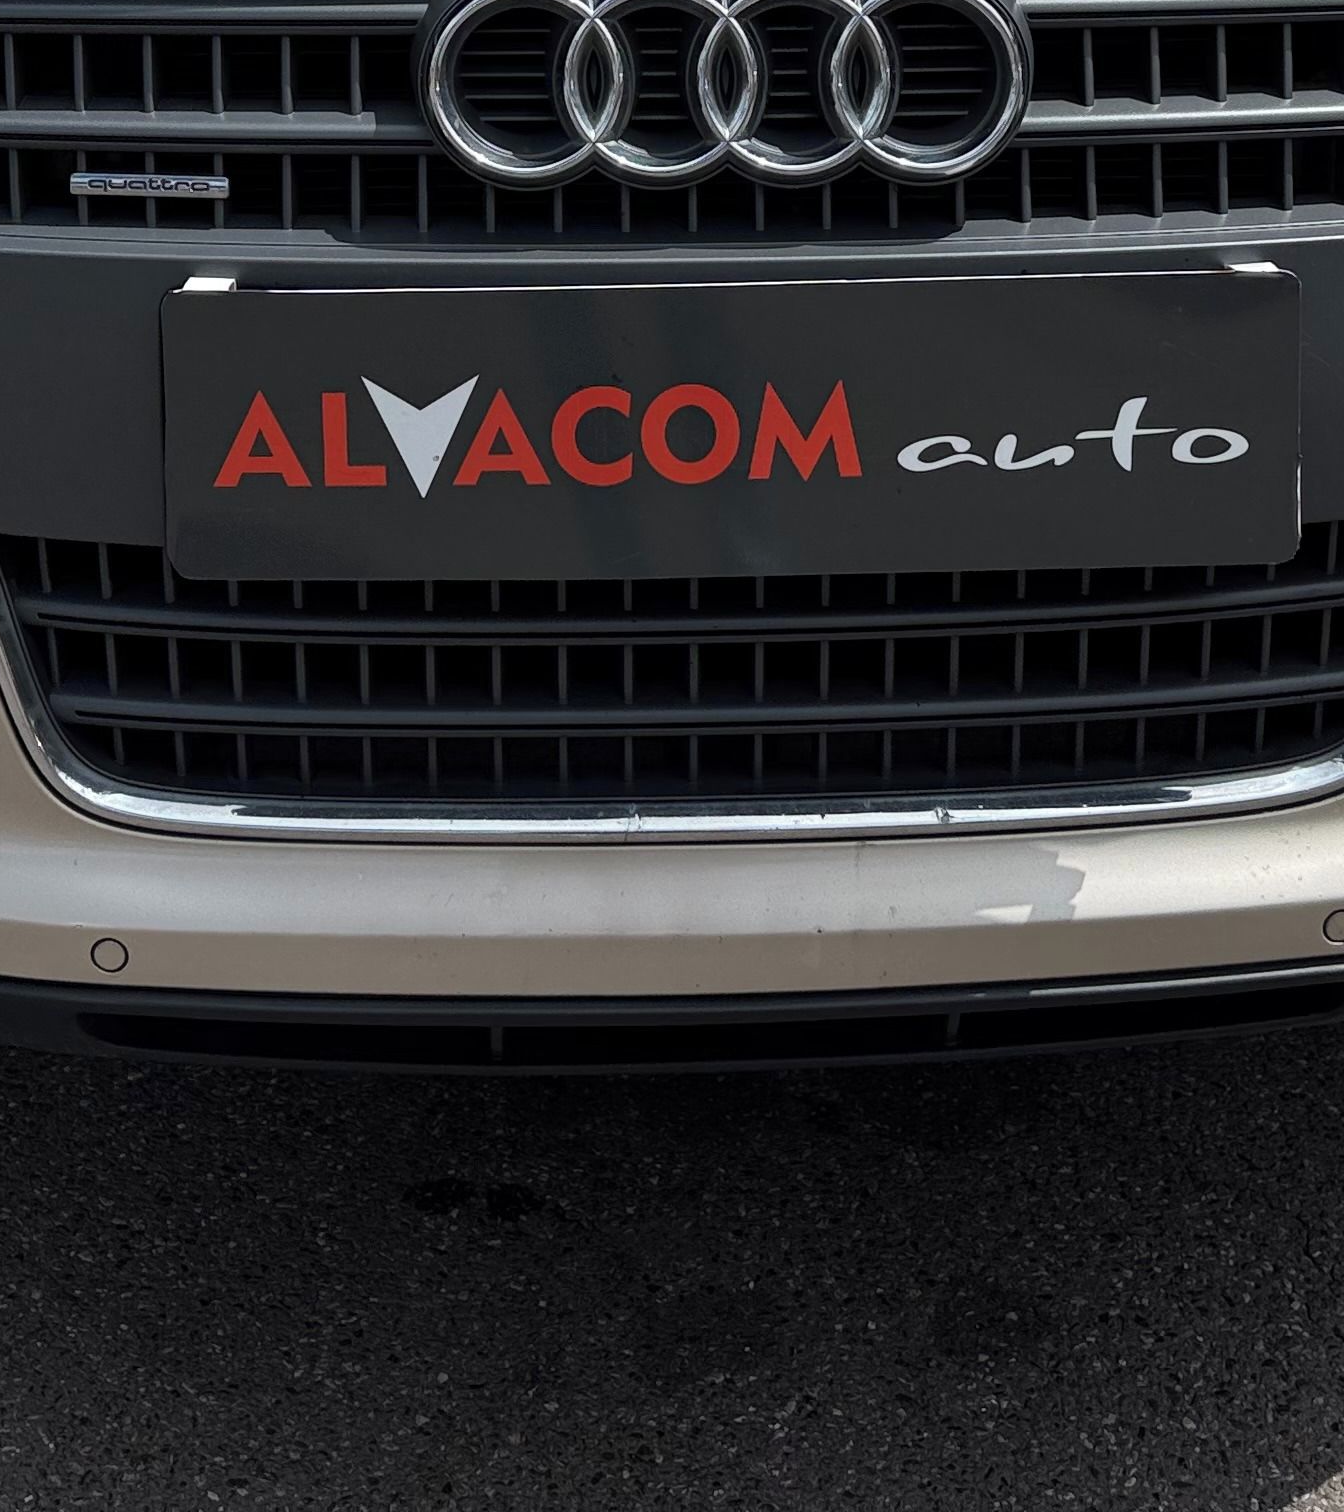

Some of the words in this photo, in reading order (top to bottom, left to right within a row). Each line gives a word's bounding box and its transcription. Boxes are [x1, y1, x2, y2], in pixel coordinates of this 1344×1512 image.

[86, 177, 211, 193] quattro
[212, 374, 863, 499] ALVACOM
[896, 396, 1252, 473] auto
